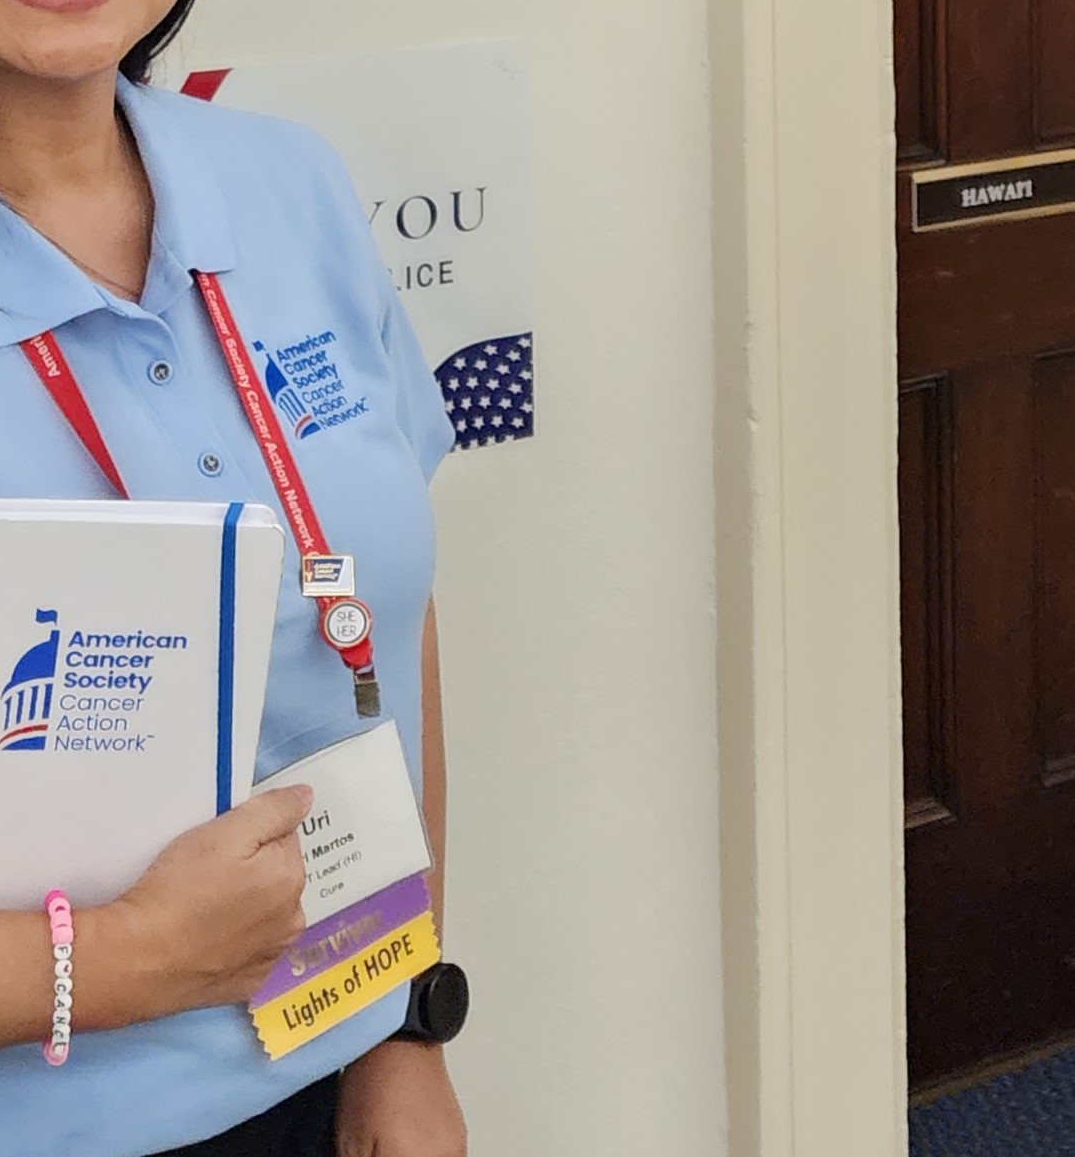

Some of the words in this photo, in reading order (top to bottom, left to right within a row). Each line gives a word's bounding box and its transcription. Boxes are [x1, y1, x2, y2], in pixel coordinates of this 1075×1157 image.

[276, 331, 337, 363] American
[283, 350, 328, 375] Cancer
[292, 363, 338, 389] Society
[302, 379, 344, 404] Cancer
[311, 395, 348, 417] Action
[226, 337, 251, 389] Society
[246, 389, 272, 440] Cancer
[264, 442, 291, 488] Action
[284, 489, 314, 549] Network
[67, 630, 187, 650] American
[336, 625, 357, 637] HER
[65, 651, 154, 669] Cancer
[63, 671, 153, 695] Society
[59, 694, 145, 712] Cancer
[56, 714, 128, 732] Action
[301, 810, 331, 836] Uri
[311, 832, 354, 860] Martos
[282, 986, 340, 1031] Lights
[343, 964, 362, 995] of
[363, 933, 415, 981] HOPE
